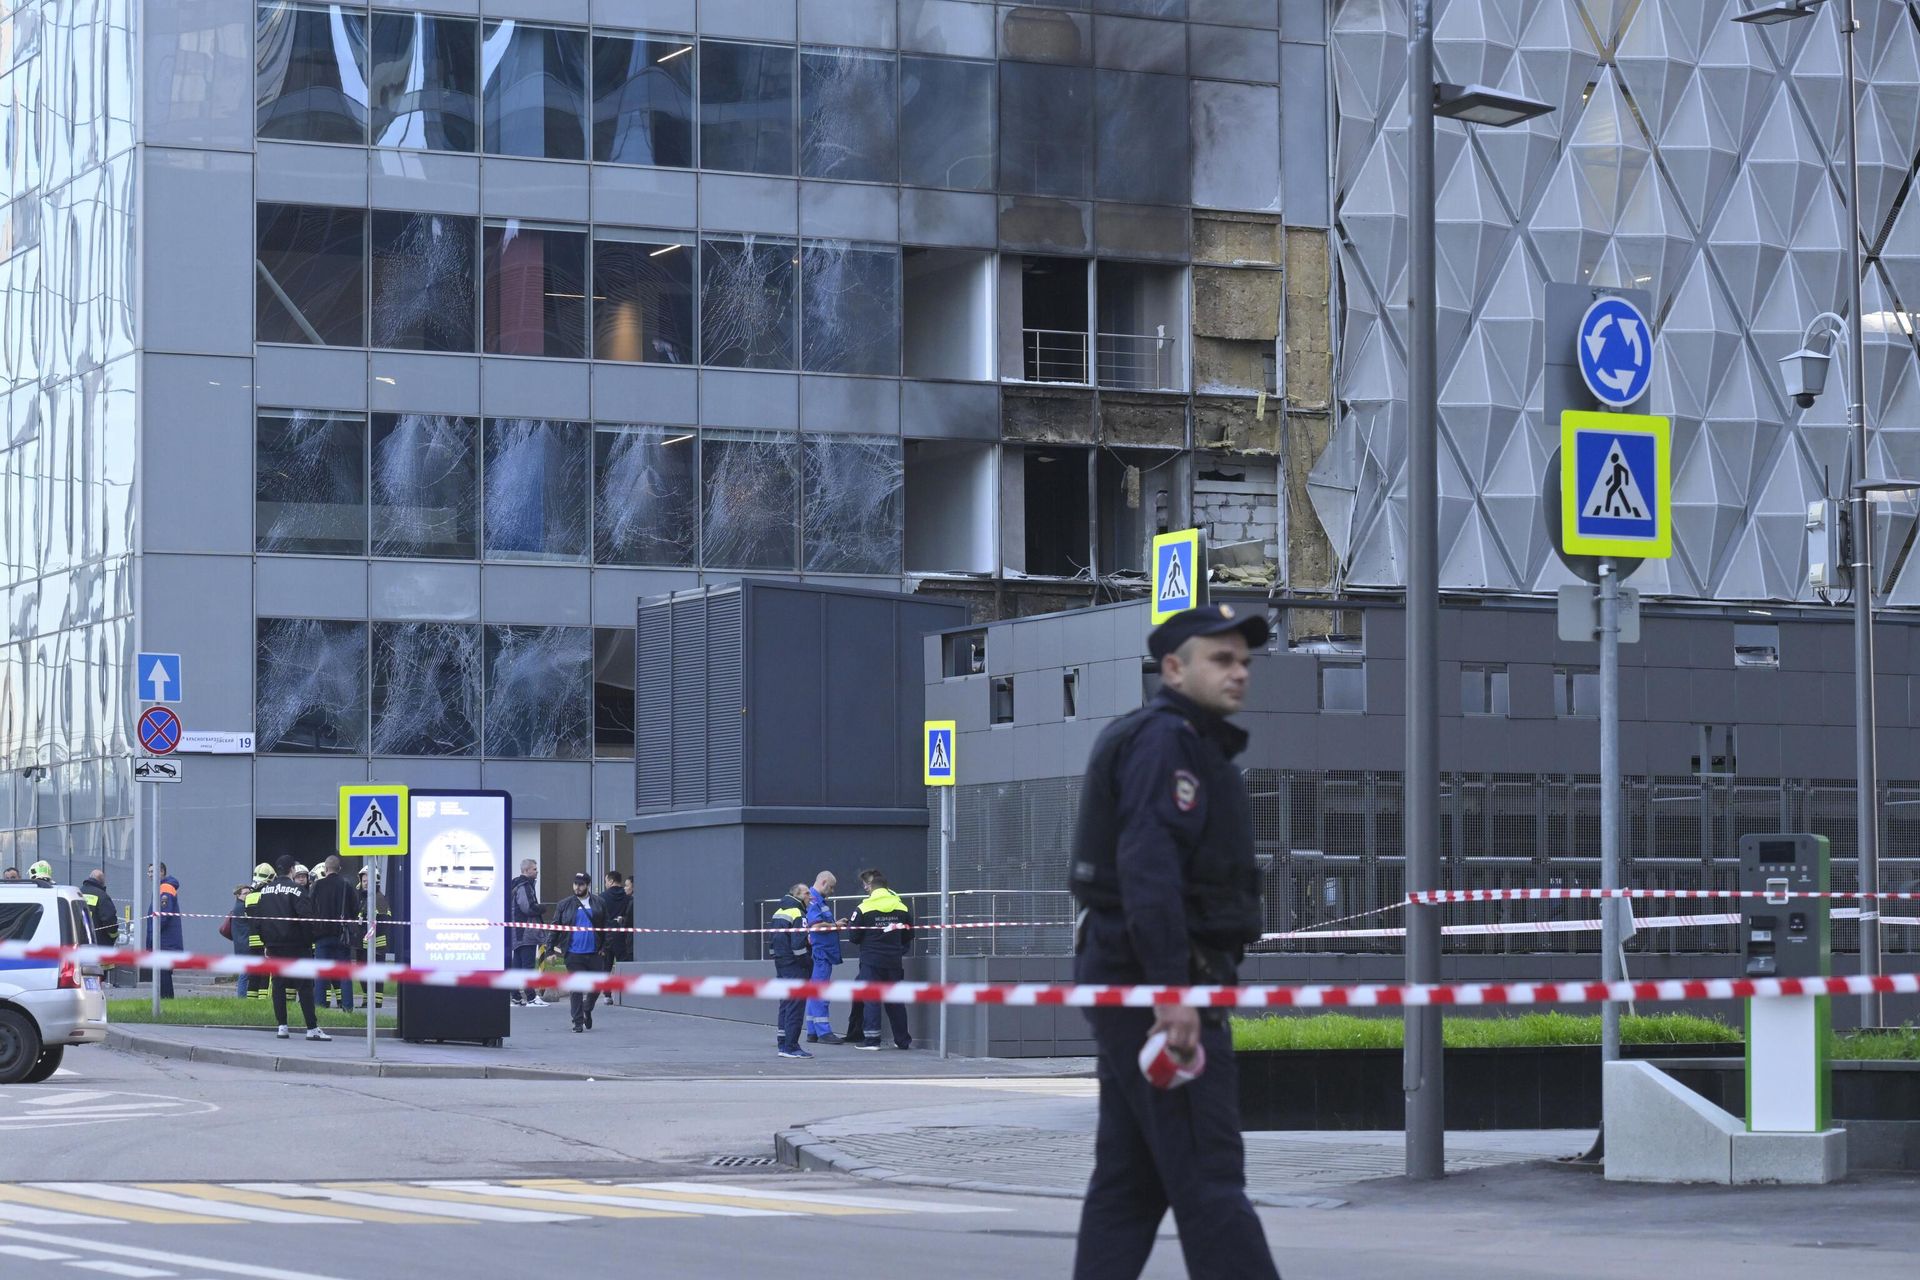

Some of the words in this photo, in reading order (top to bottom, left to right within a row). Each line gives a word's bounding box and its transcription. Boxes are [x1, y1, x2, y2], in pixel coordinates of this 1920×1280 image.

[239, 737, 252, 748] 19
[261, 885, 275, 895] alm
[274, 883, 302, 897] Angels
[436, 932, 480, 941] ФАБРИКА
[425, 942, 491, 951] МОРОЖЕНОГО
[430, 952, 443, 961] НА
[456, 952, 486, 961] ЭТАЖЕ
